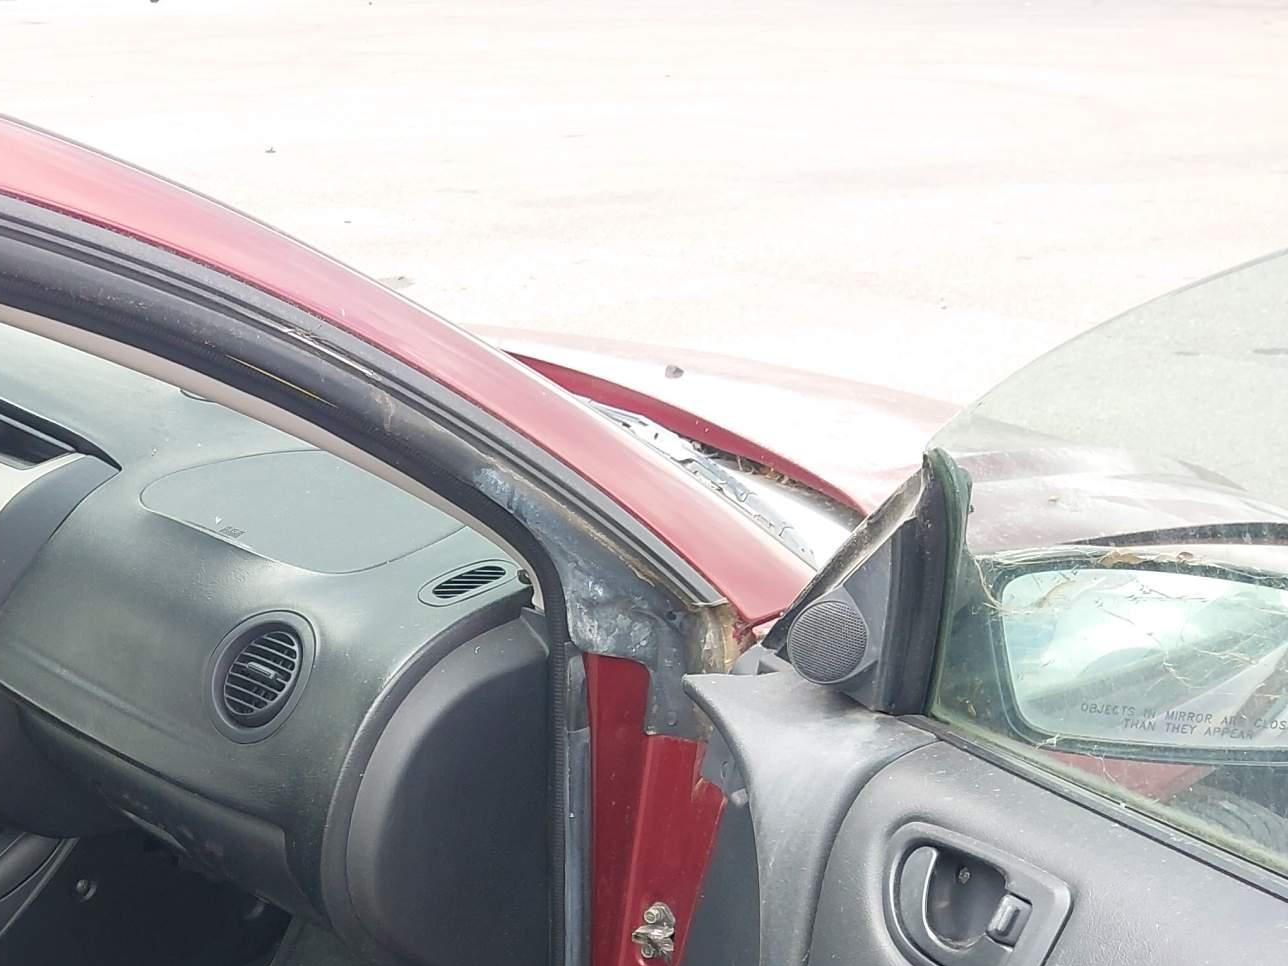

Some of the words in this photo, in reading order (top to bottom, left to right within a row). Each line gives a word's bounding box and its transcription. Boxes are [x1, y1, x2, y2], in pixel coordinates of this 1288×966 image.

[1080, 702, 1135, 717] OBJECTS
[1142, 708, 1156, 719] IN
[1165, 710, 1213, 723] MIRROR
[1254, 717, 1288, 730] CLOS
[1123, 718, 1156, 732] THAN
[1164, 722, 1197, 736] THEY
[1203, 726, 1254, 740] APPEAR
